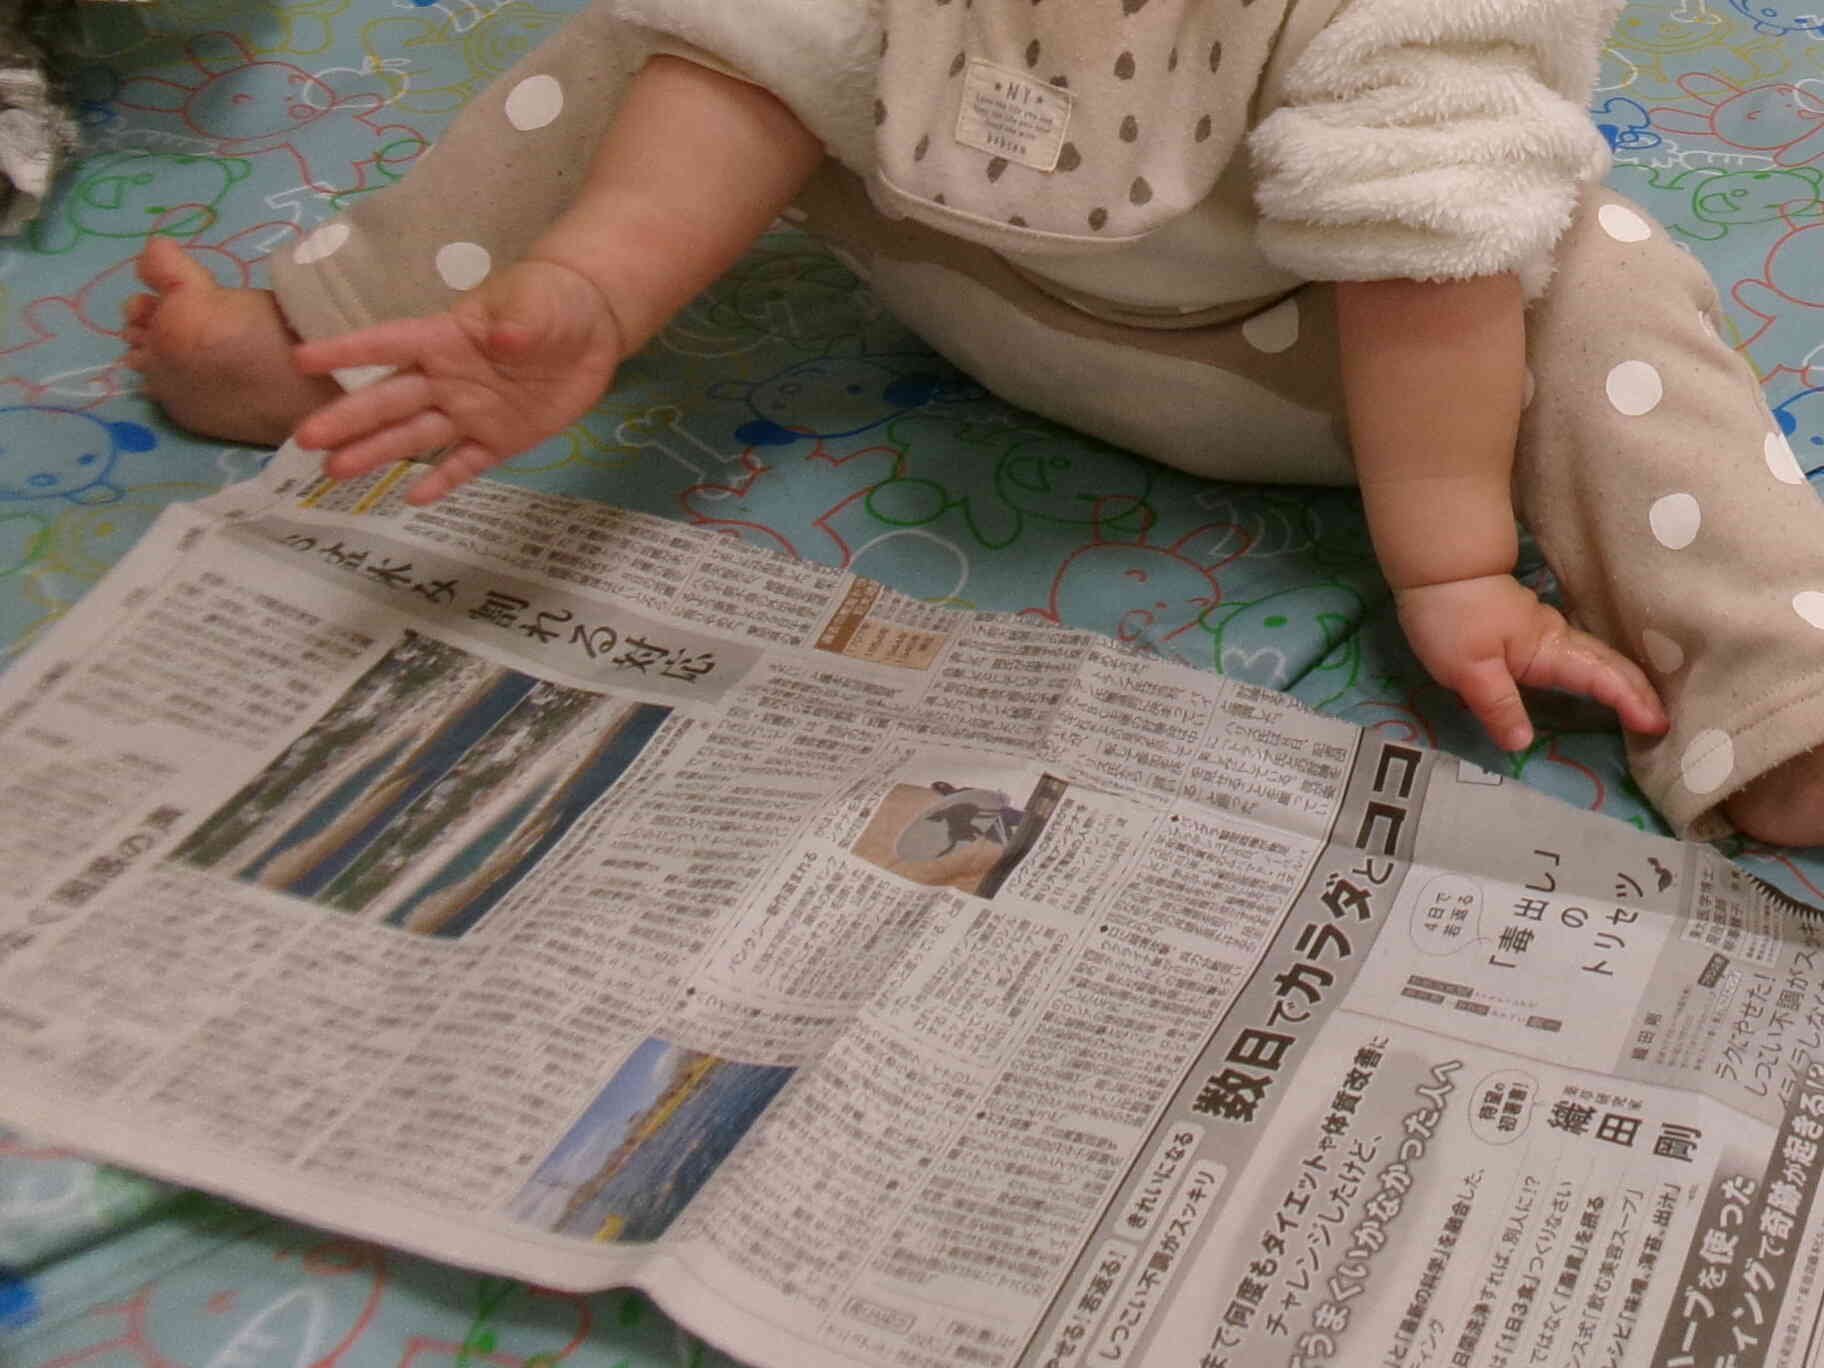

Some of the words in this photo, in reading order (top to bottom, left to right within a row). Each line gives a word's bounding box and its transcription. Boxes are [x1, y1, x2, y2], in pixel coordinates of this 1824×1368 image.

[1190, 741, 1428, 1127] 数日でカラダとココ
